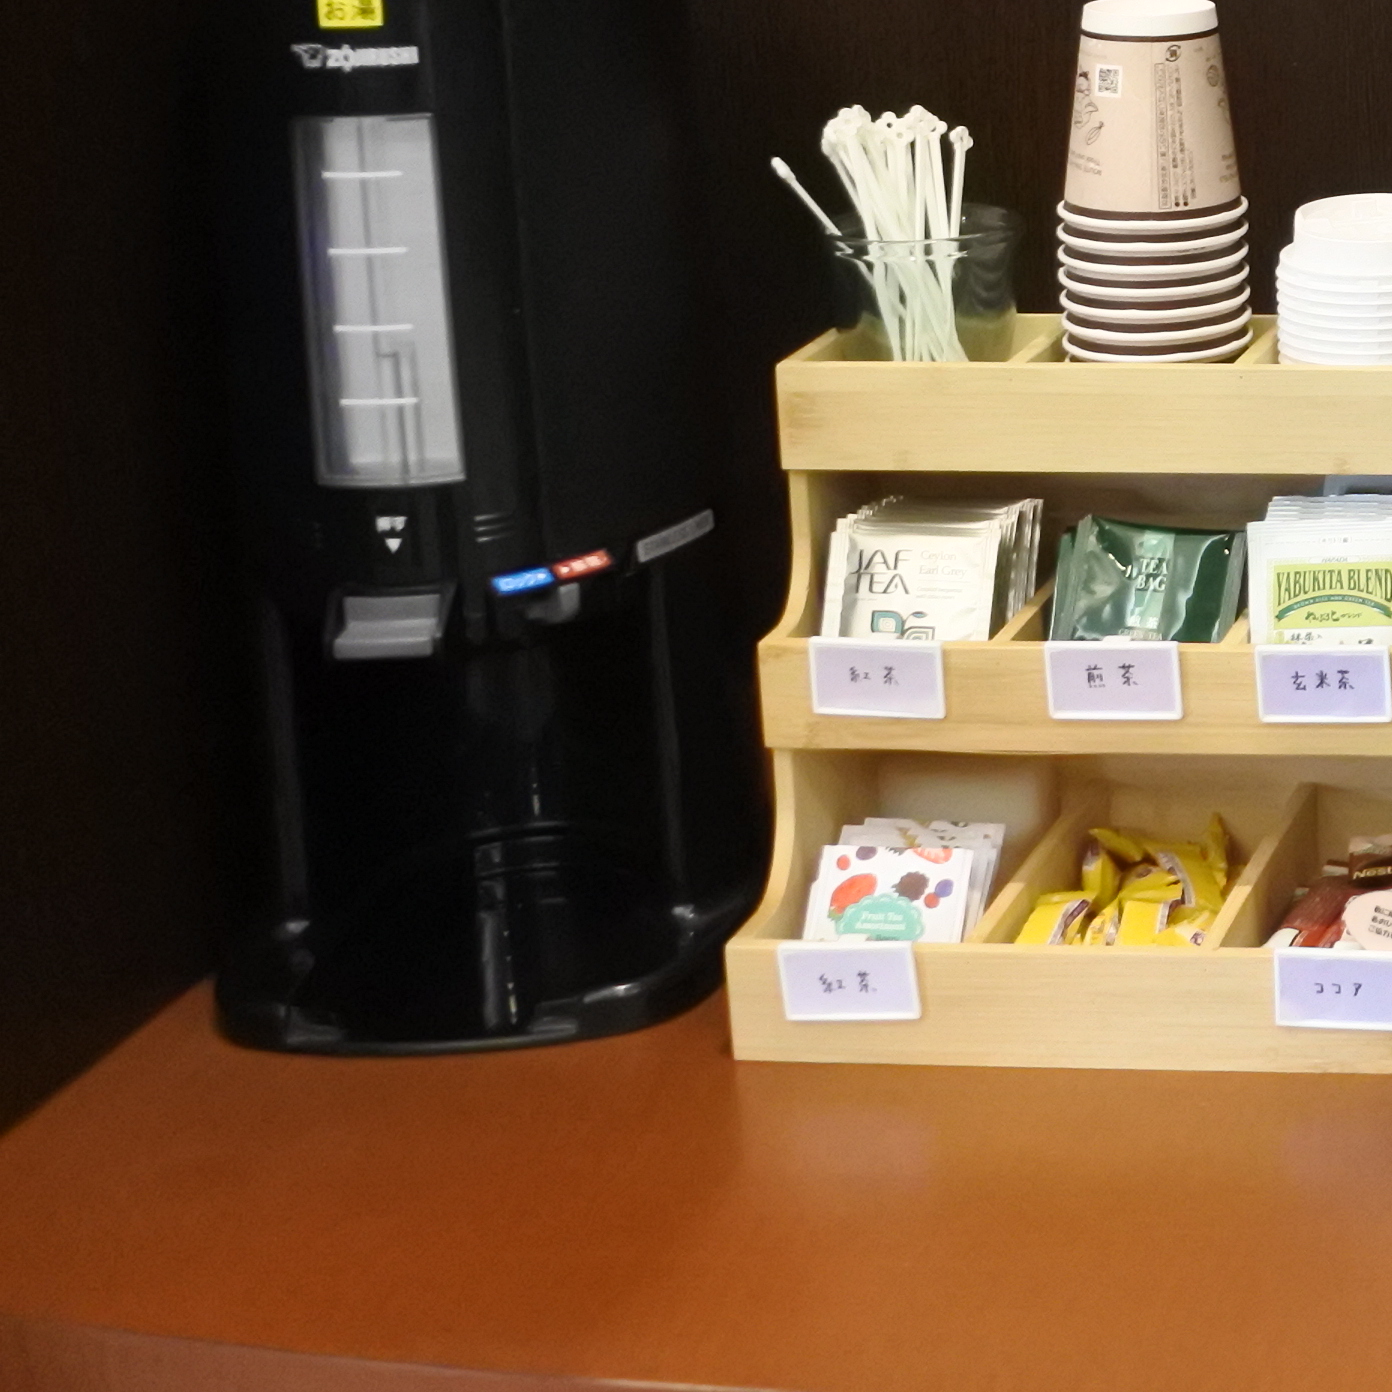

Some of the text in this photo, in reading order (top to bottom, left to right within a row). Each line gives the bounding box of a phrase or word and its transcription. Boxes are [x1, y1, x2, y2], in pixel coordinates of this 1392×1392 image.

[851, 549, 912, 574] JAF
[920, 550, 957, 563] Ceylon
[1140, 558, 1168, 575] TEA
[919, 565, 968, 579] Earl Grey
[854, 572, 910, 594] TEA
[1136, 574, 1167, 591] BAG
[1276, 569, 1344, 607] YABUKITA
[849, 666, 899, 686] 紅茶
[1086, 663, 1138, 689] 煎茶
[1291, 670, 1355, 691] 玄米茶
[1314, 983, 1362, 996] ココア
